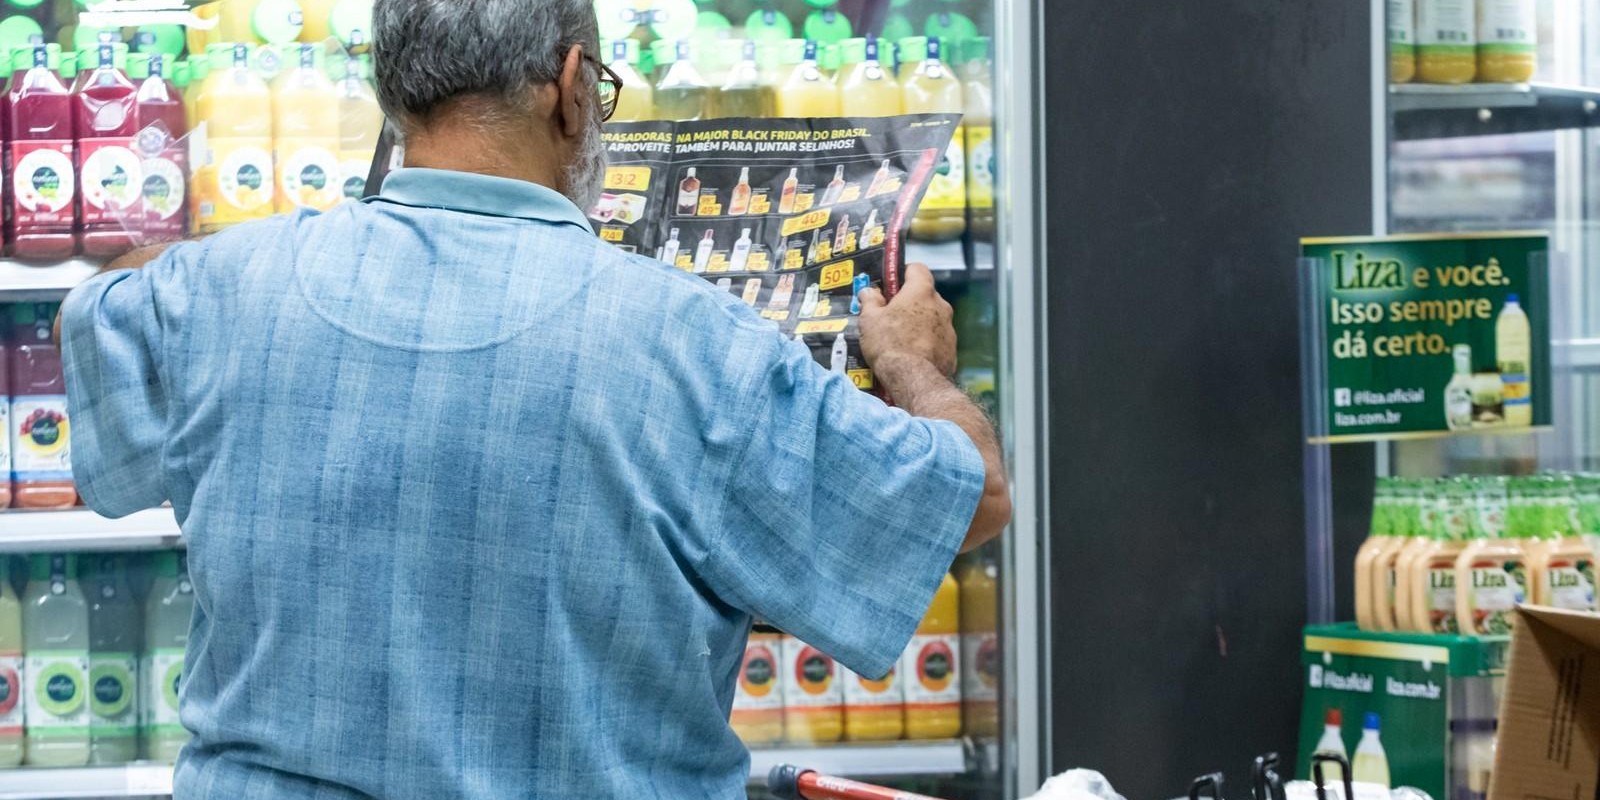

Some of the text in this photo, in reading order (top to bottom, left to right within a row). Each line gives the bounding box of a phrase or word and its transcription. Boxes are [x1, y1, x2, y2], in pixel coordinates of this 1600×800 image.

[676, 133, 691, 143] NA
[693, 130, 730, 141] MAIOR
[731, 129, 768, 140] BLACK
[770, 130, 812, 141] FRIDAY
[813, 130, 830, 141] DO
[831, 127, 872, 139] BRASIL.
[608, 142, 671, 153] APROVEITE
[675, 139, 720, 154] TAMBÉM
[721, 140, 752, 152] PARA
[754, 141, 797, 153] JUNTAR
[798, 139, 855, 151] SELINHOS!
[1333, 251, 1511, 290] Liza e você.
[1331, 297, 1493, 327] Isso sempre
[1332, 329, 1451, 359] dá certo.
[1334, 409, 1402, 427] liza.com.br
[1472, 571, 1507, 588] Liza
